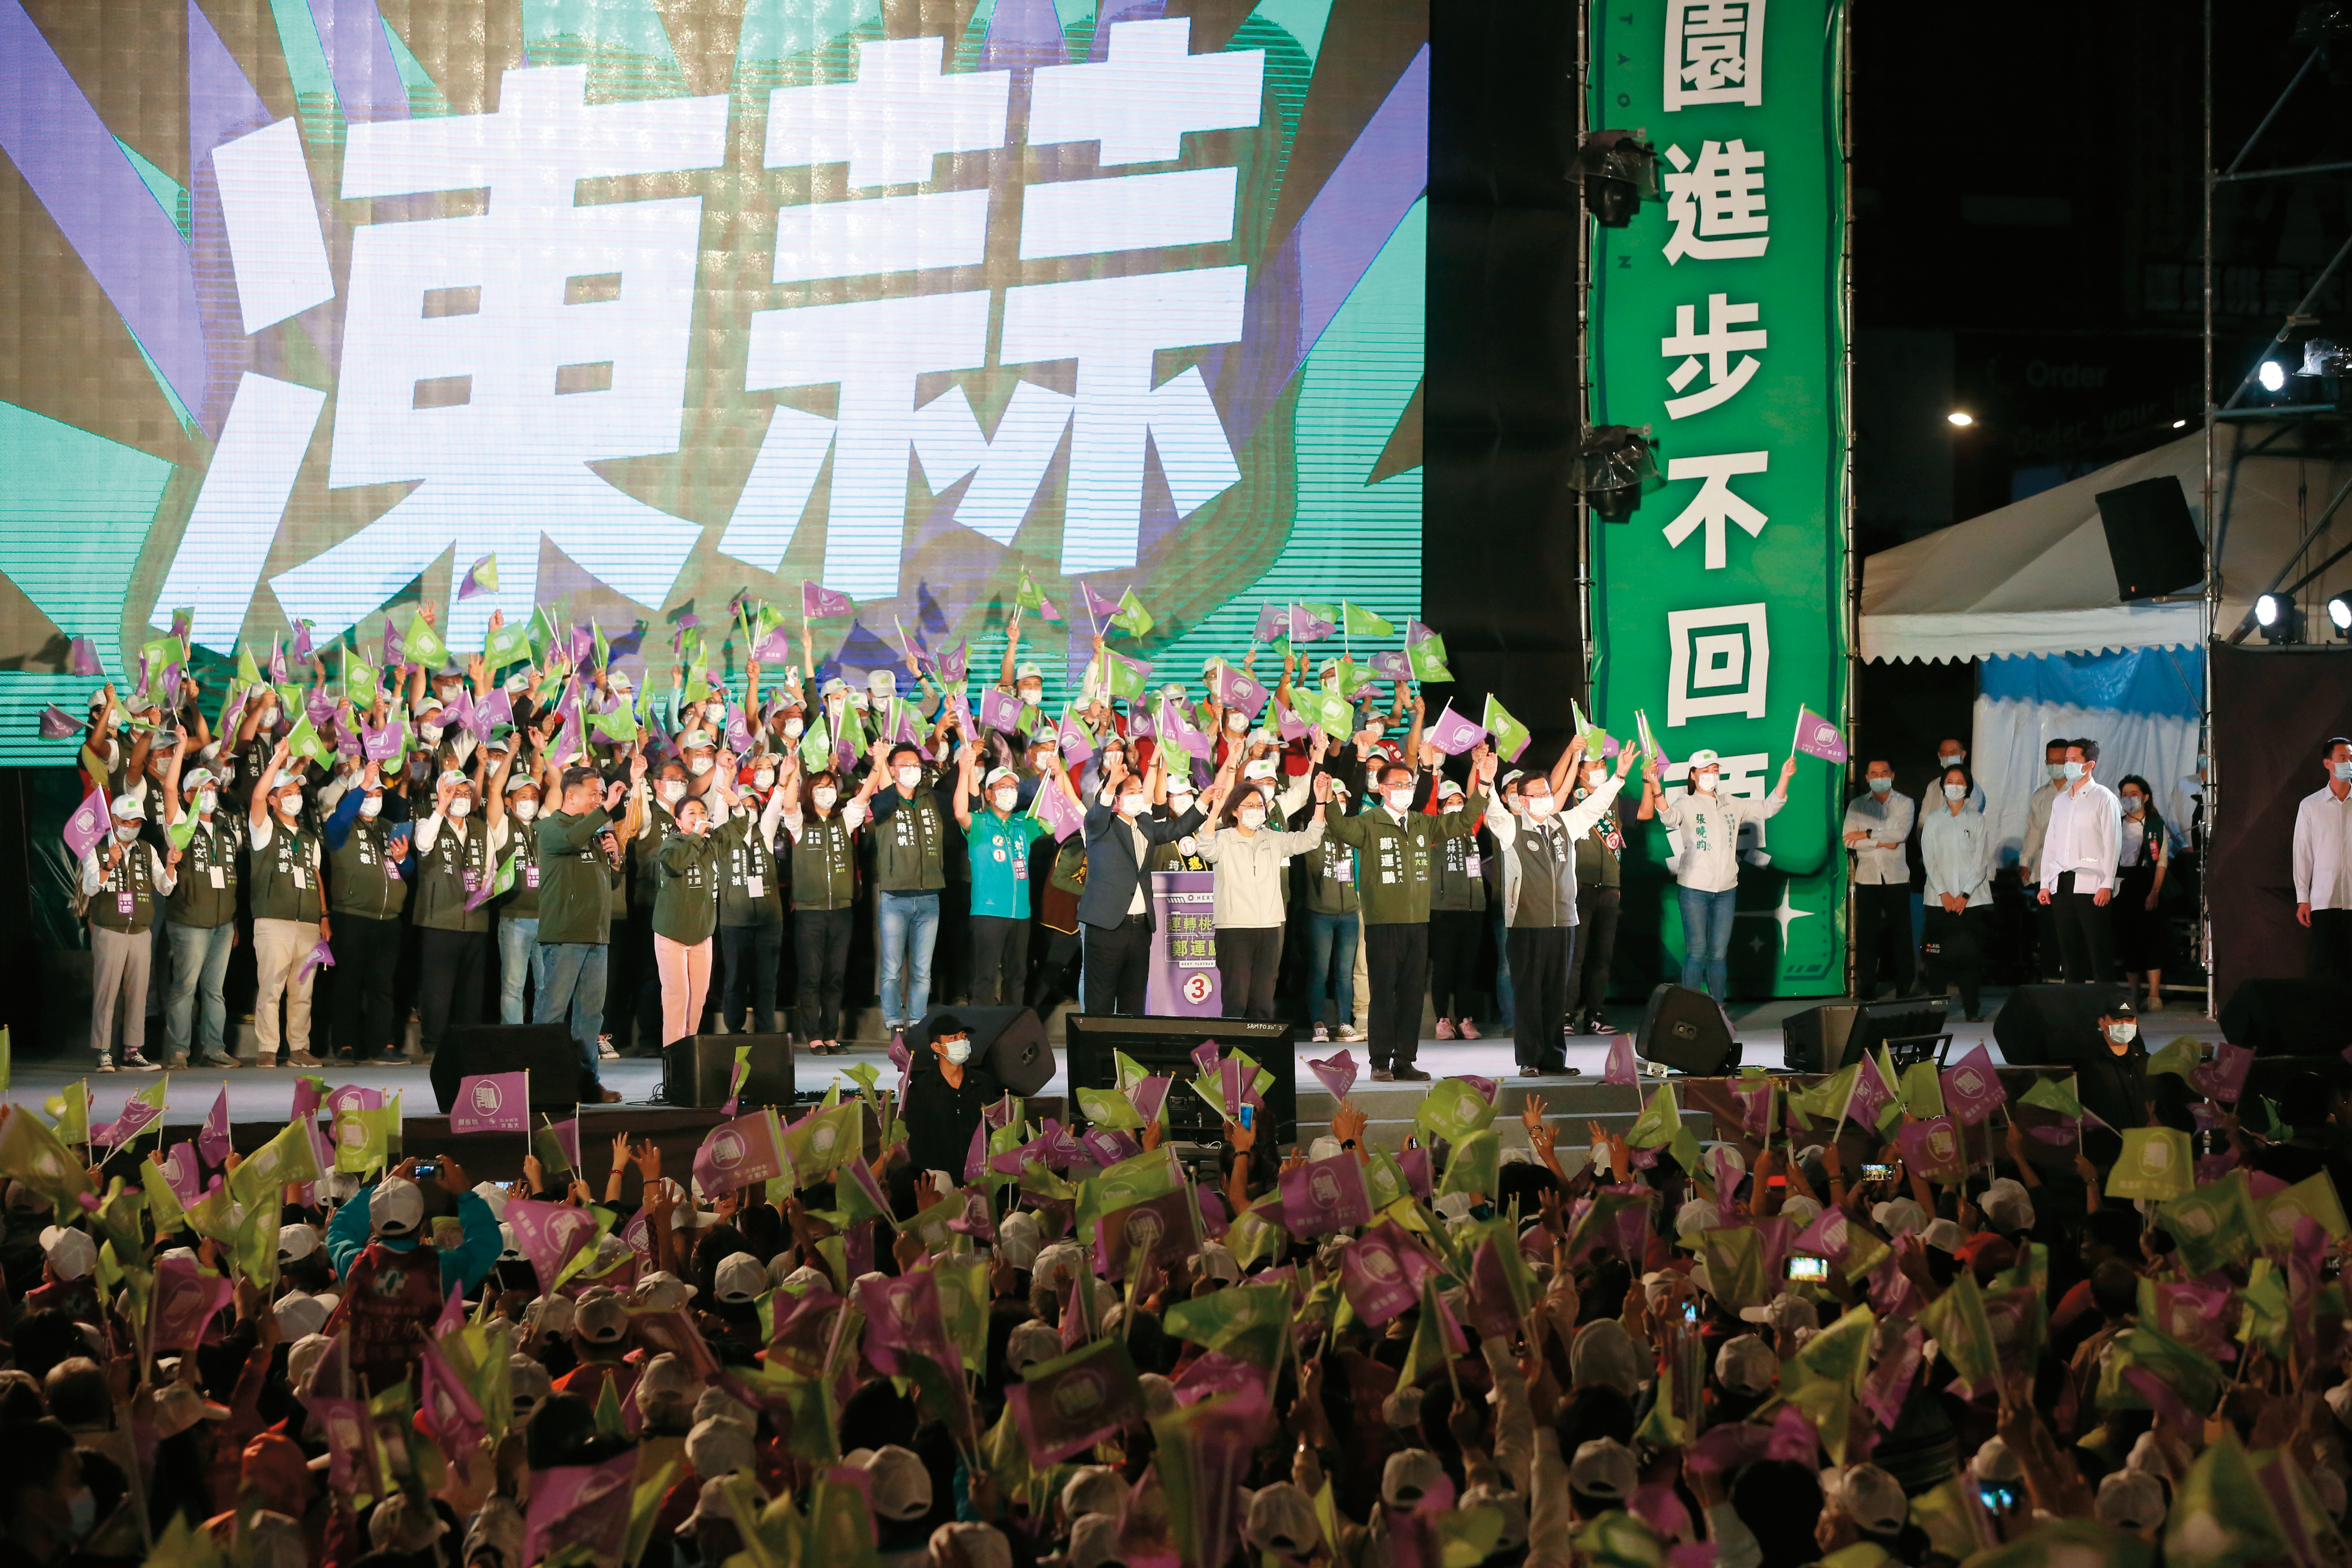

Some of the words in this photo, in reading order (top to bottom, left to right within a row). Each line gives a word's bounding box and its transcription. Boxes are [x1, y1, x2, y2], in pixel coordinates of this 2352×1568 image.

[1617, 13, 1633, 270] TAON
[149, 17, 1264, 649] 凍蒜
[1182, 841, 1193, 851] 17
[1607, 834, 1617, 849] 5
[1696, 813, 1707, 851] 張曉昀
[1379, 837, 1396, 884] 鄭運鵬
[1168, 917, 1214, 932] 運轉桃
[1191, 978, 1205, 999] 3
